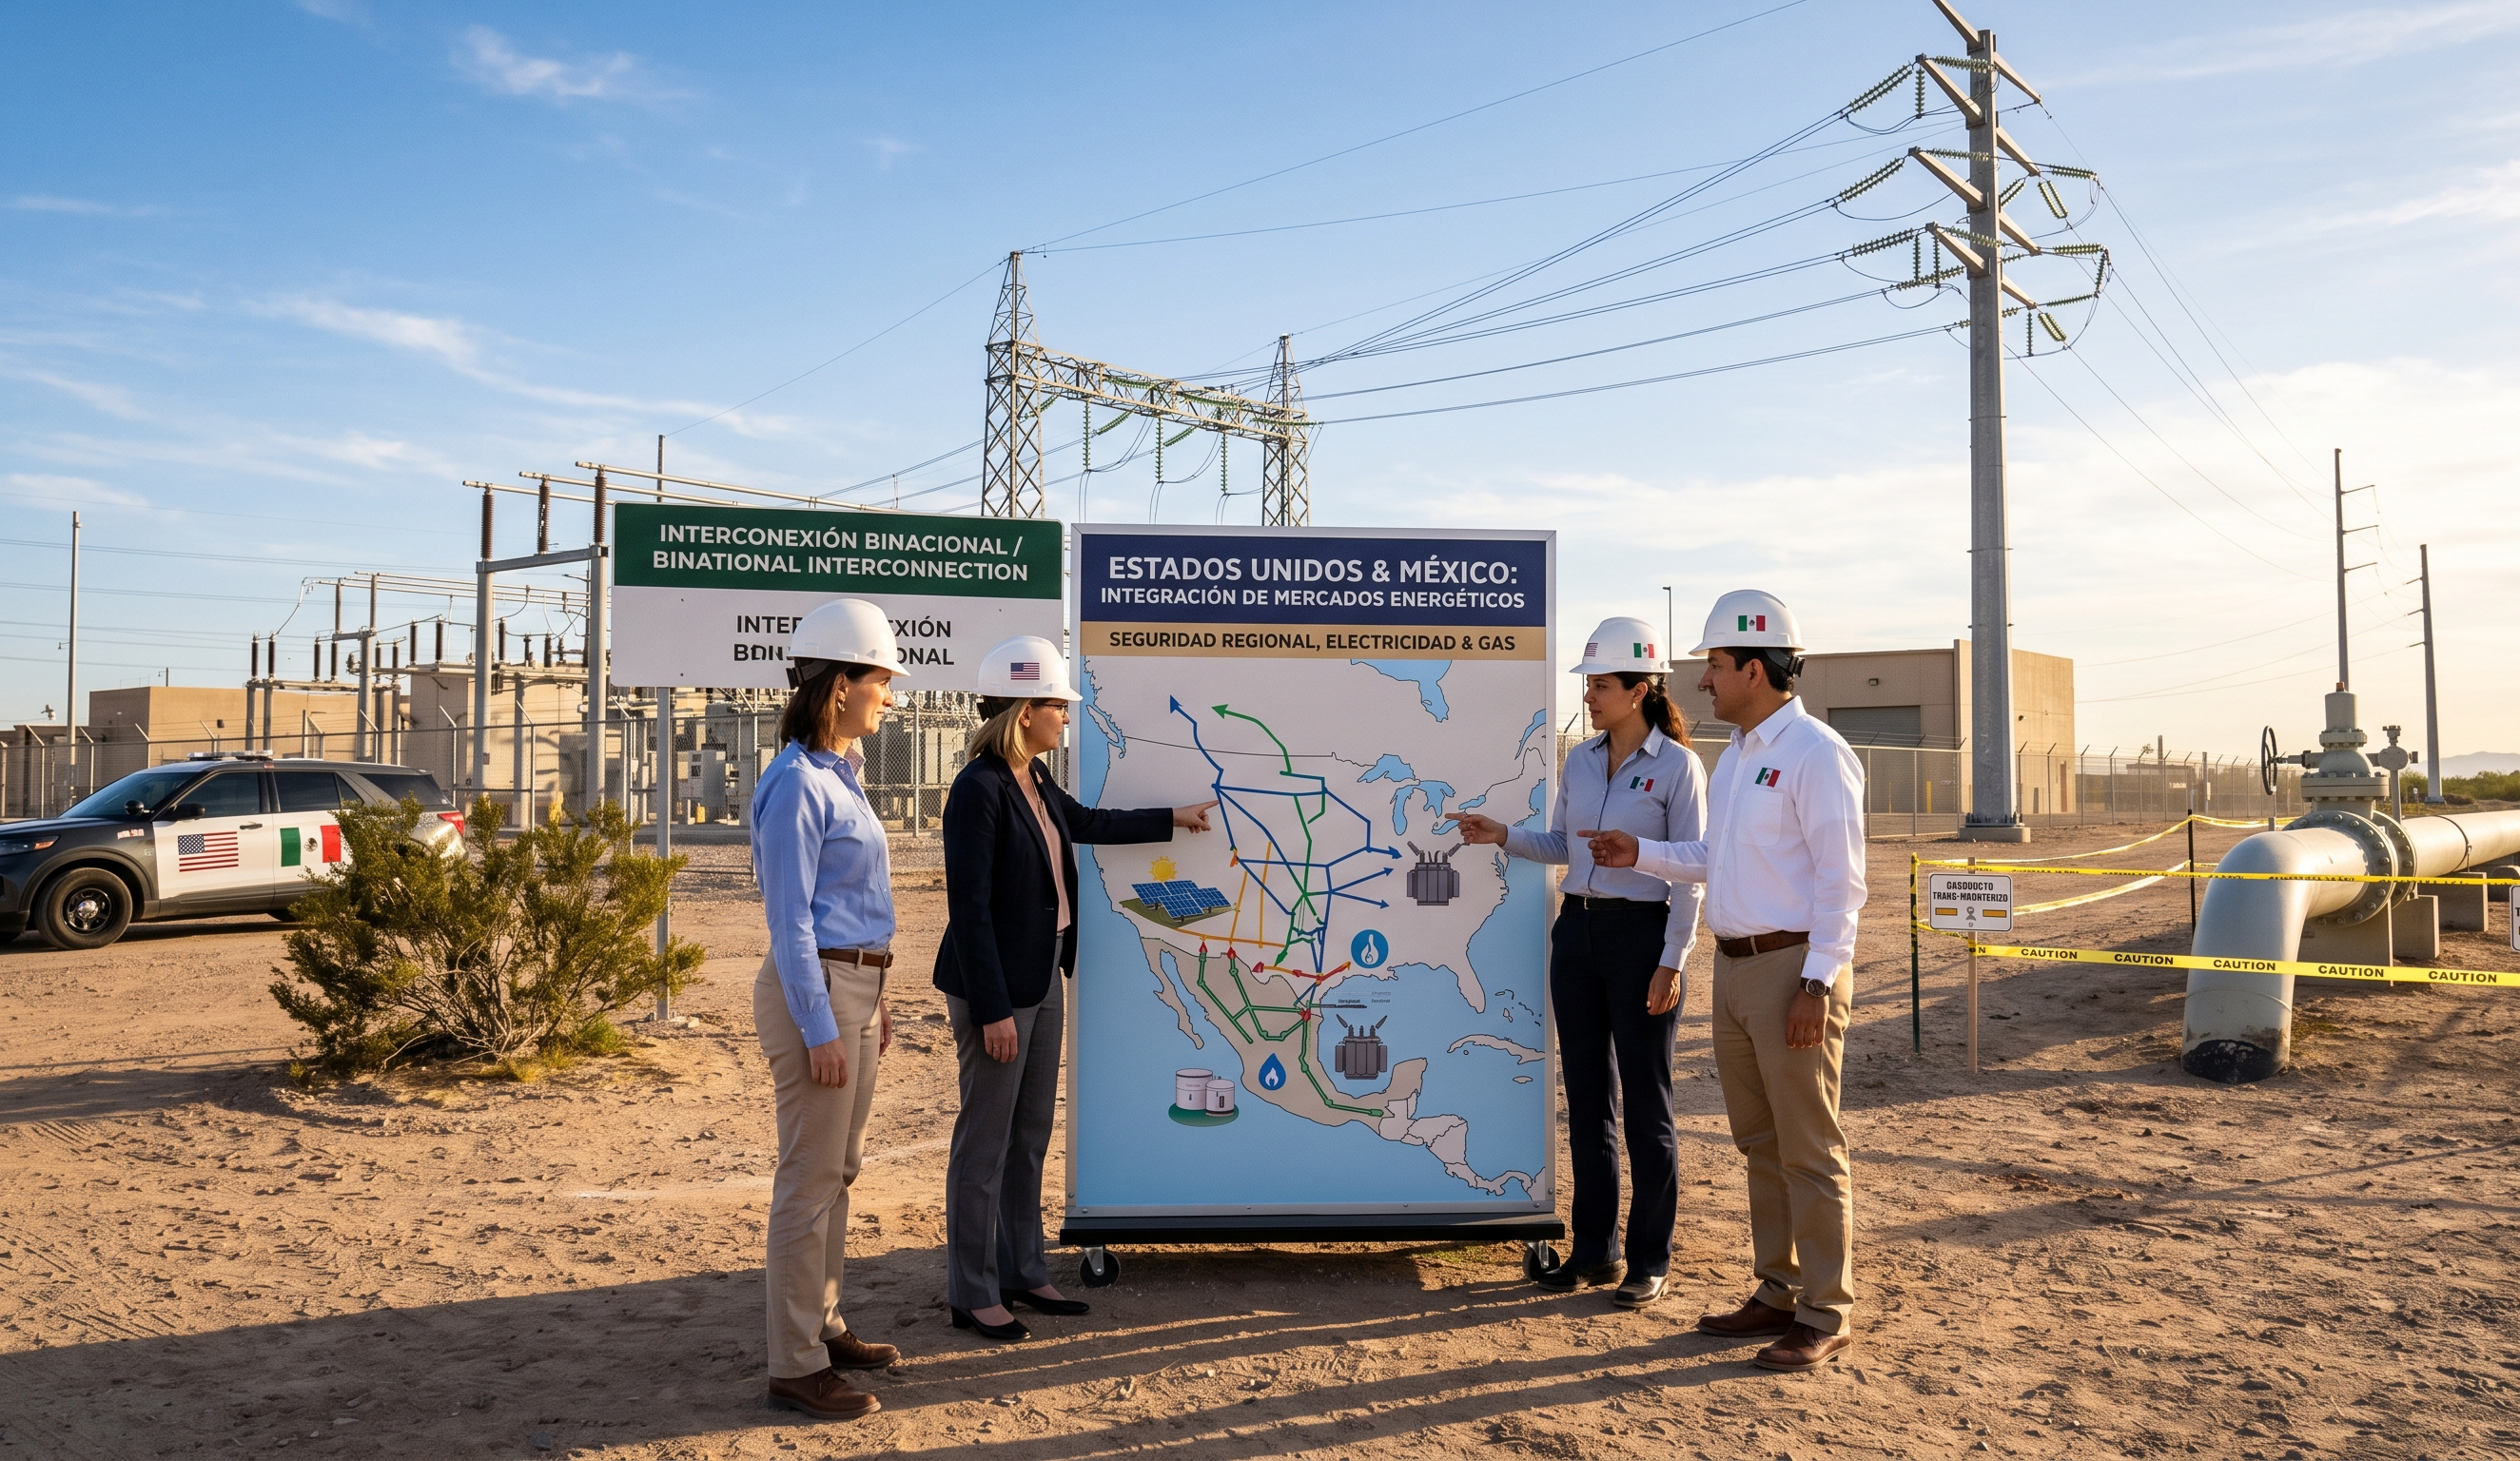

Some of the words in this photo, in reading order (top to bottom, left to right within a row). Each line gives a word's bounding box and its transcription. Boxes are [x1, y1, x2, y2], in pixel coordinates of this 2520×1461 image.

[659, 524, 856, 549] INTERCONEXIÓN
[865, 532, 1008, 555] BINACIONAL
[653, 550, 802, 574] BINATIONAL
[808, 555, 1027, 581] INTERCONNECTION
[1109, 556, 1242, 581] ESTADOS
[1251, 557, 1363, 582] UNIDOS
[1371, 559, 1391, 583] &
[1399, 554, 1517, 585] MÉXICO:
[1101, 584, 1236, 605] INTEGRACIÓN
[1242, 589, 1269, 606] DE
[1274, 590, 1385, 607] MERCADOS
[1390, 587, 1525, 609] ENERGÉTICOS
[1109, 631, 1217, 648] SEGURIDAD
[1221, 633, 1320, 652] REGIONAL,
[1326, 633, 1456, 651] ELECTRICIDAD
[1461, 634, 1474, 651] &
[1477, 635, 1515, 651] GAS
[2021, 948, 2078, 960] CAUTION
[2114, 953, 2174, 965] CAUTION
[2213, 959, 2276, 971] CAUTION
[2317, 964, 2385, 978] CAUTION
[2428, 970, 2498, 984] CAUTION
